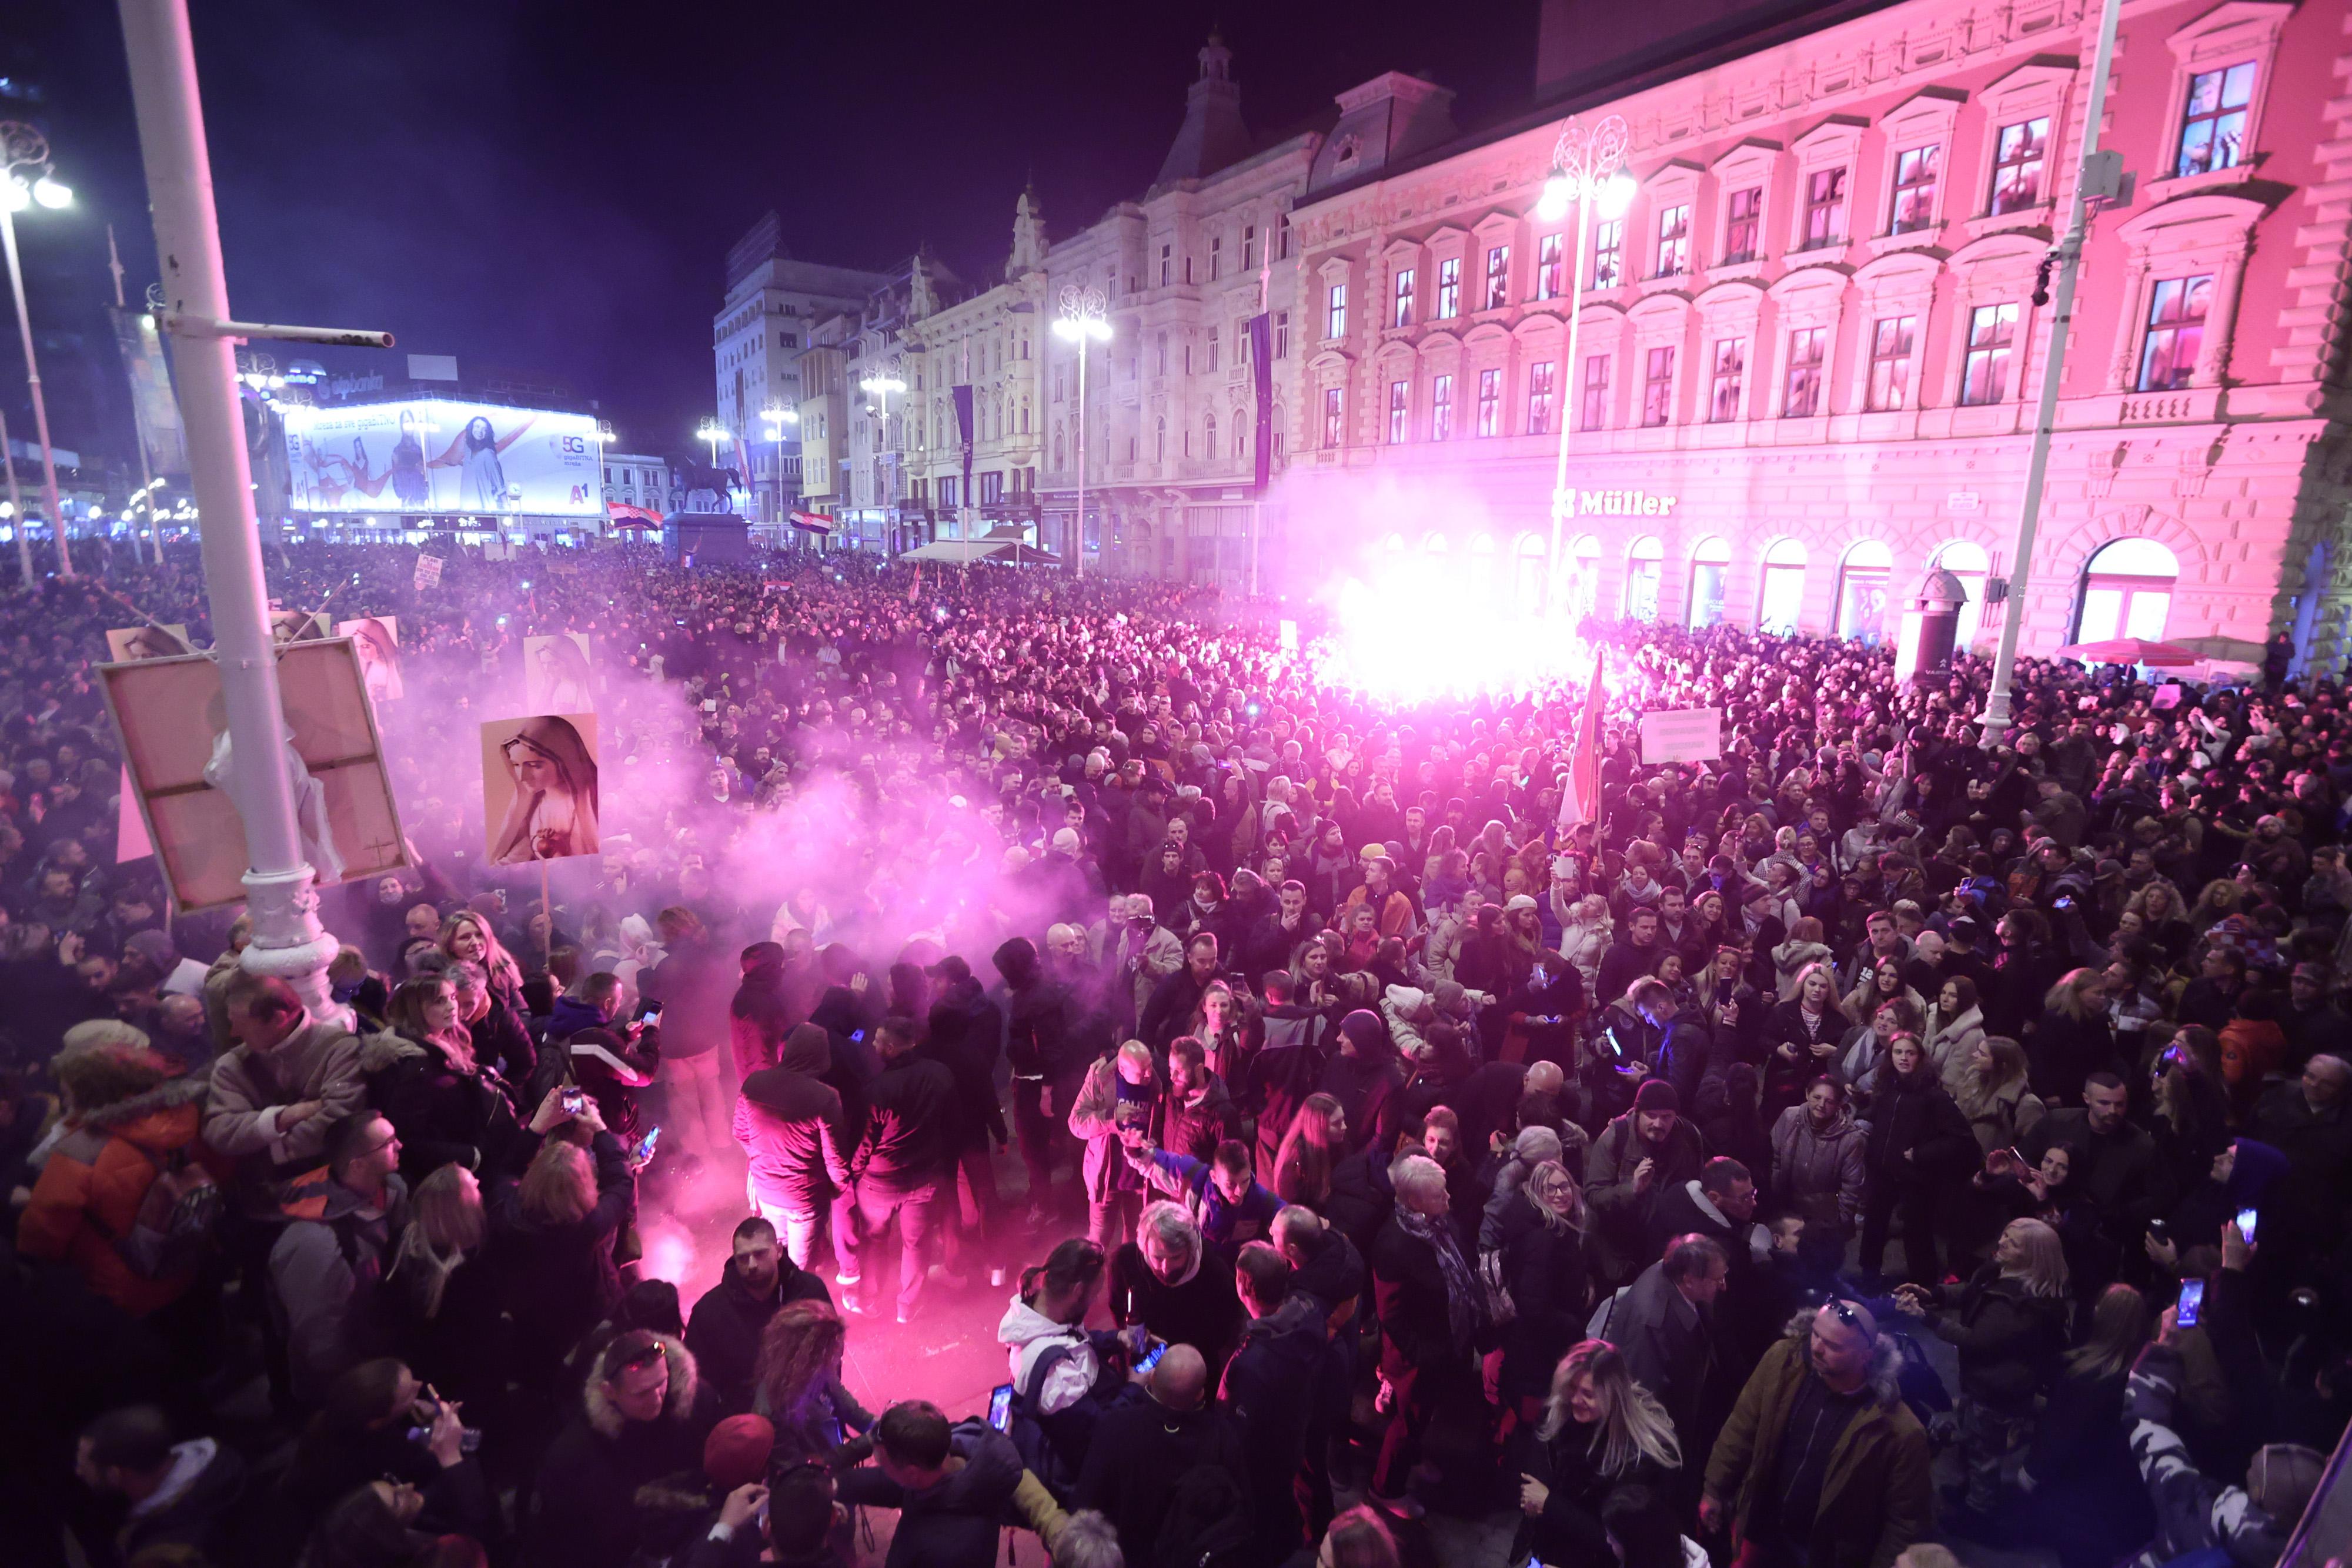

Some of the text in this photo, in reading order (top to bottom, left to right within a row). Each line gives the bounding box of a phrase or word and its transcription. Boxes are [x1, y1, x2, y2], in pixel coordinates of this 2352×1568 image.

[563, 436, 584, 453] 5G
[569, 483, 588, 504] A1
[1579, 490, 1678, 516] Müller
